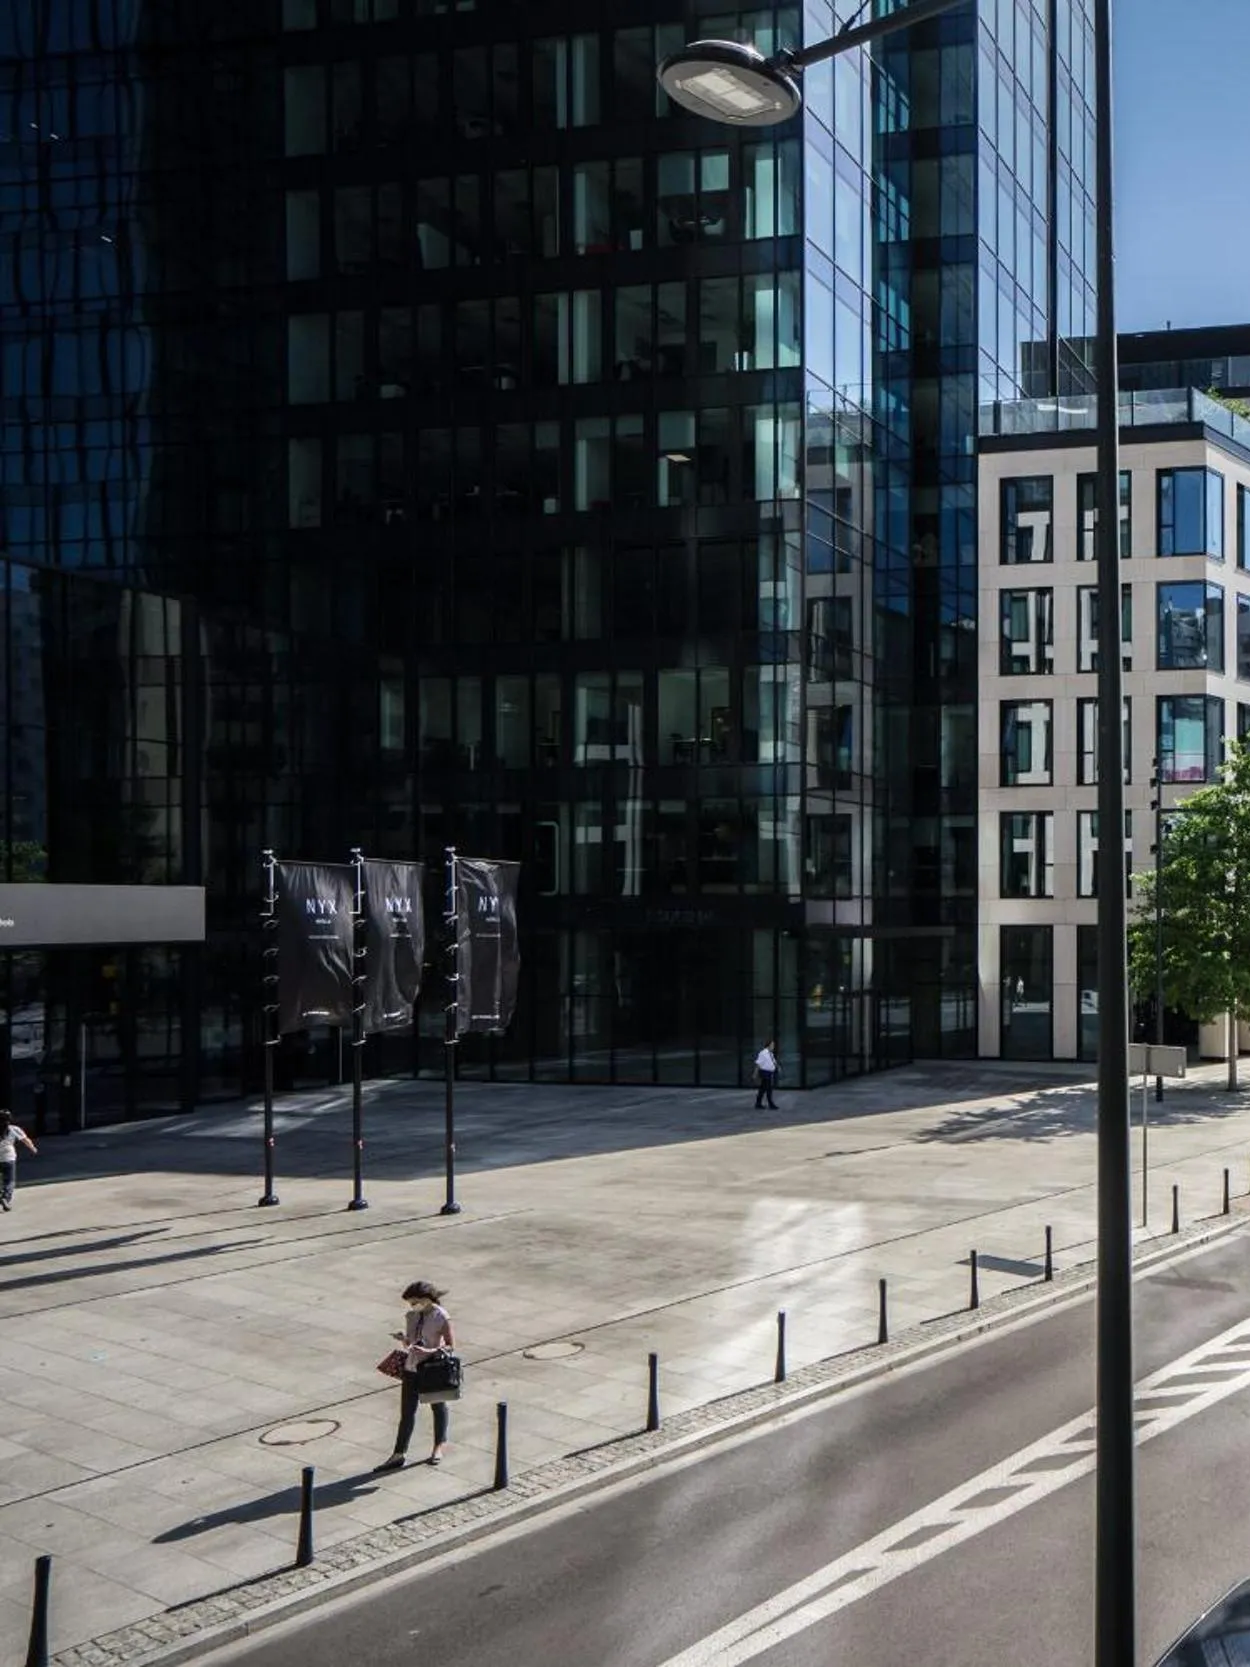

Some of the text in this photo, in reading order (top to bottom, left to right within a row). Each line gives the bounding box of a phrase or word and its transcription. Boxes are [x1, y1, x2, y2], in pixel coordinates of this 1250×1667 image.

[306, 897, 338, 914] NYX
[385, 897, 412, 913] NYX
[478, 896, 500, 912] NY
